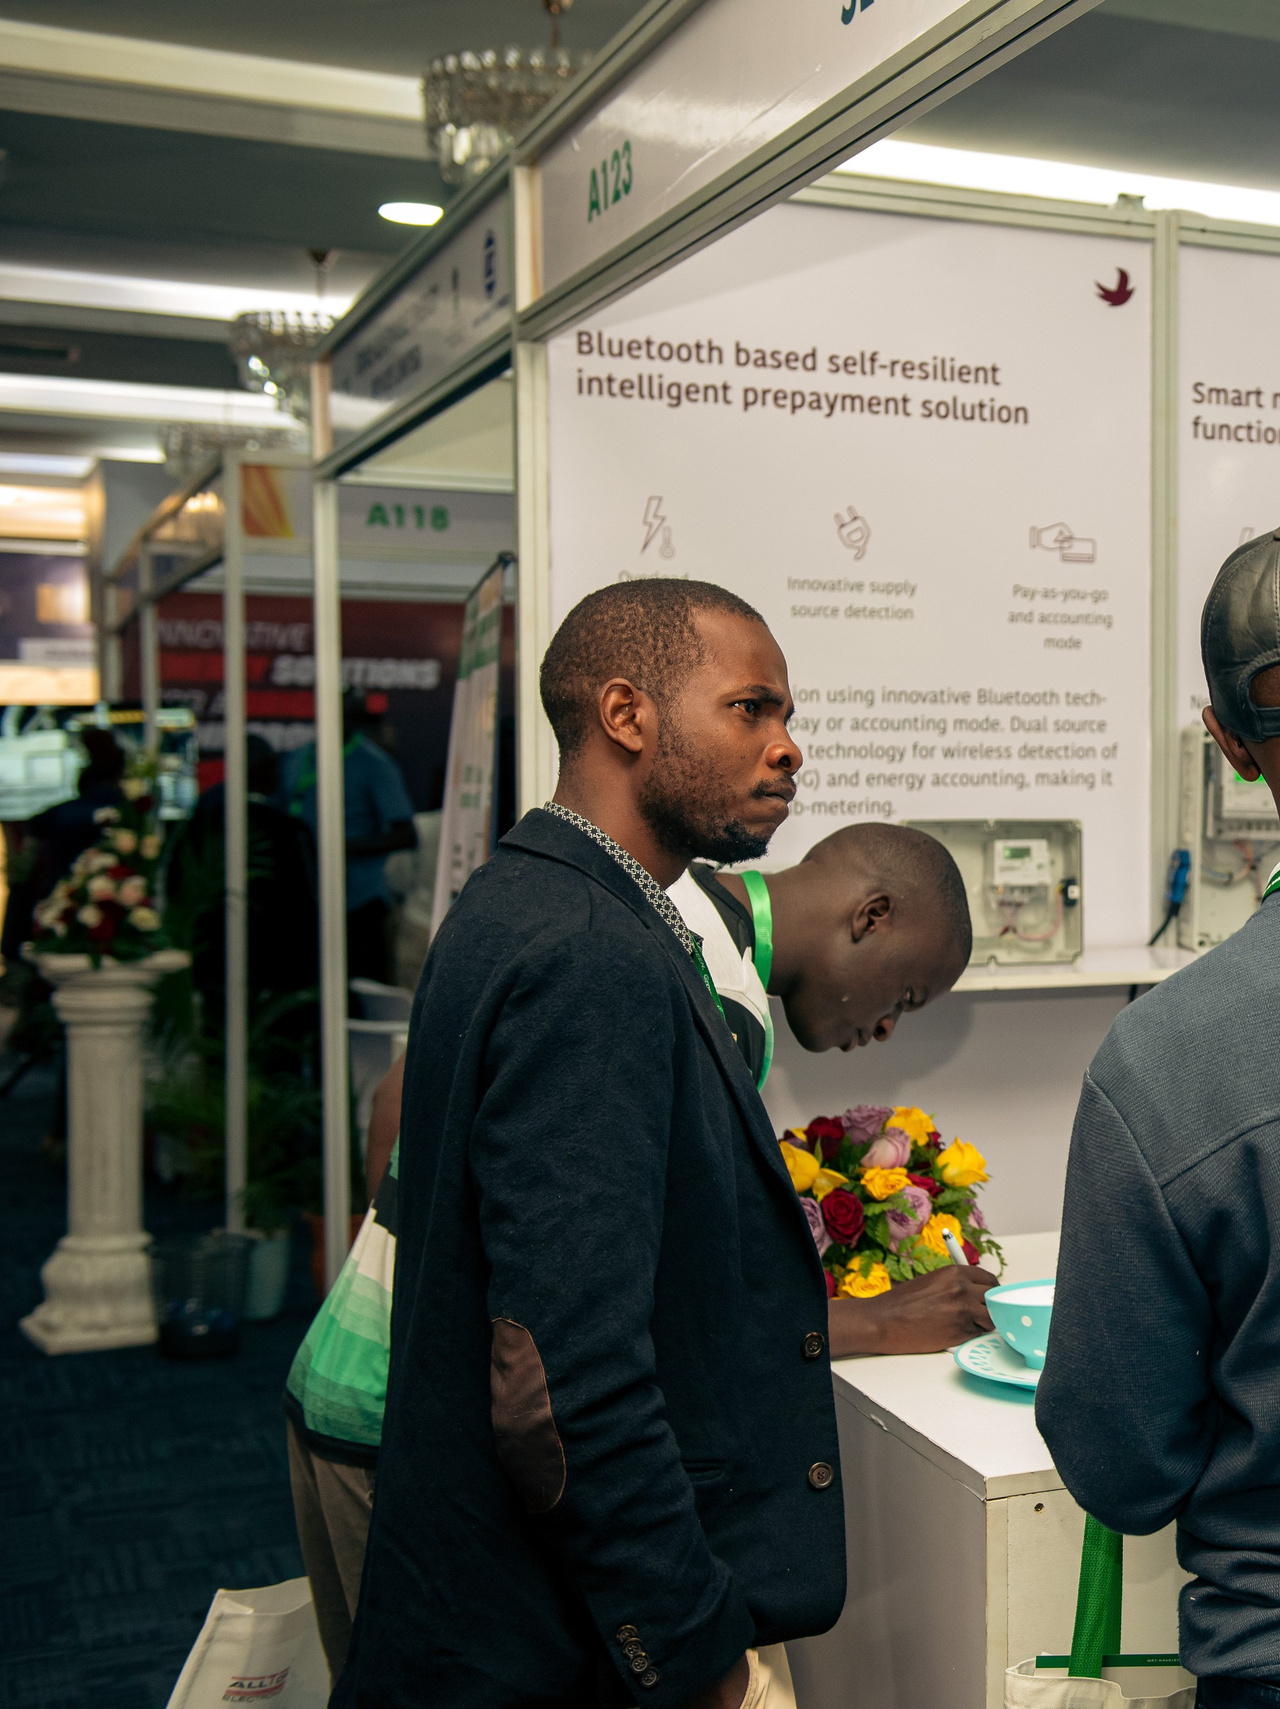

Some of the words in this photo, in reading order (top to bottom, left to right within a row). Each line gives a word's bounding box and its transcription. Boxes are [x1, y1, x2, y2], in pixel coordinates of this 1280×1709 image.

[587, 139, 634, 223] A123
[576, 330, 723, 366] Bluetooth
[735, 340, 817, 372] based
[827, 349, 1001, 387] self-resilient
[576, 368, 732, 408] intelligent
[743, 386, 911, 418] prepayment
[920, 397, 1029, 425] solution
[1192, 382, 1264, 409] Smart
[366, 503, 450, 531] A118
[787, 576, 865, 594] Innovative
[869, 579, 918, 597] supply
[1012, 583, 1109, 603] Pay-as-you-go
[790, 604, 840, 619] source
[844, 602, 914, 620] detection
[1008, 609, 1033, 625] and
[1037, 611, 1114, 629] accounting
[1043, 634, 1083, 650] mode
[827, 686, 875, 708] using
[881, 687, 972, 706] innovative
[977, 688, 1060, 706] Bluetooth
[1065, 689, 1108, 707] tech-
[826, 717, 845, 731] or
[850, 716, 947, 735] accounting
[1010, 716, 1049, 733] Dual
[1053, 718, 1108, 734] source
[808, 743, 907, 763] technology
[912, 742, 937, 760] for
[942, 743, 1012, 759] wireless
[1017, 743, 1093, 761] detection
[1100, 742, 1119, 759] of
[826, 770, 860, 788] and
[866, 772, 927, 790] energy
[931, 770, 1031, 791] accounting,
[1035, 770, 1096, 789] making
[1101, 770, 1113, 788] it
